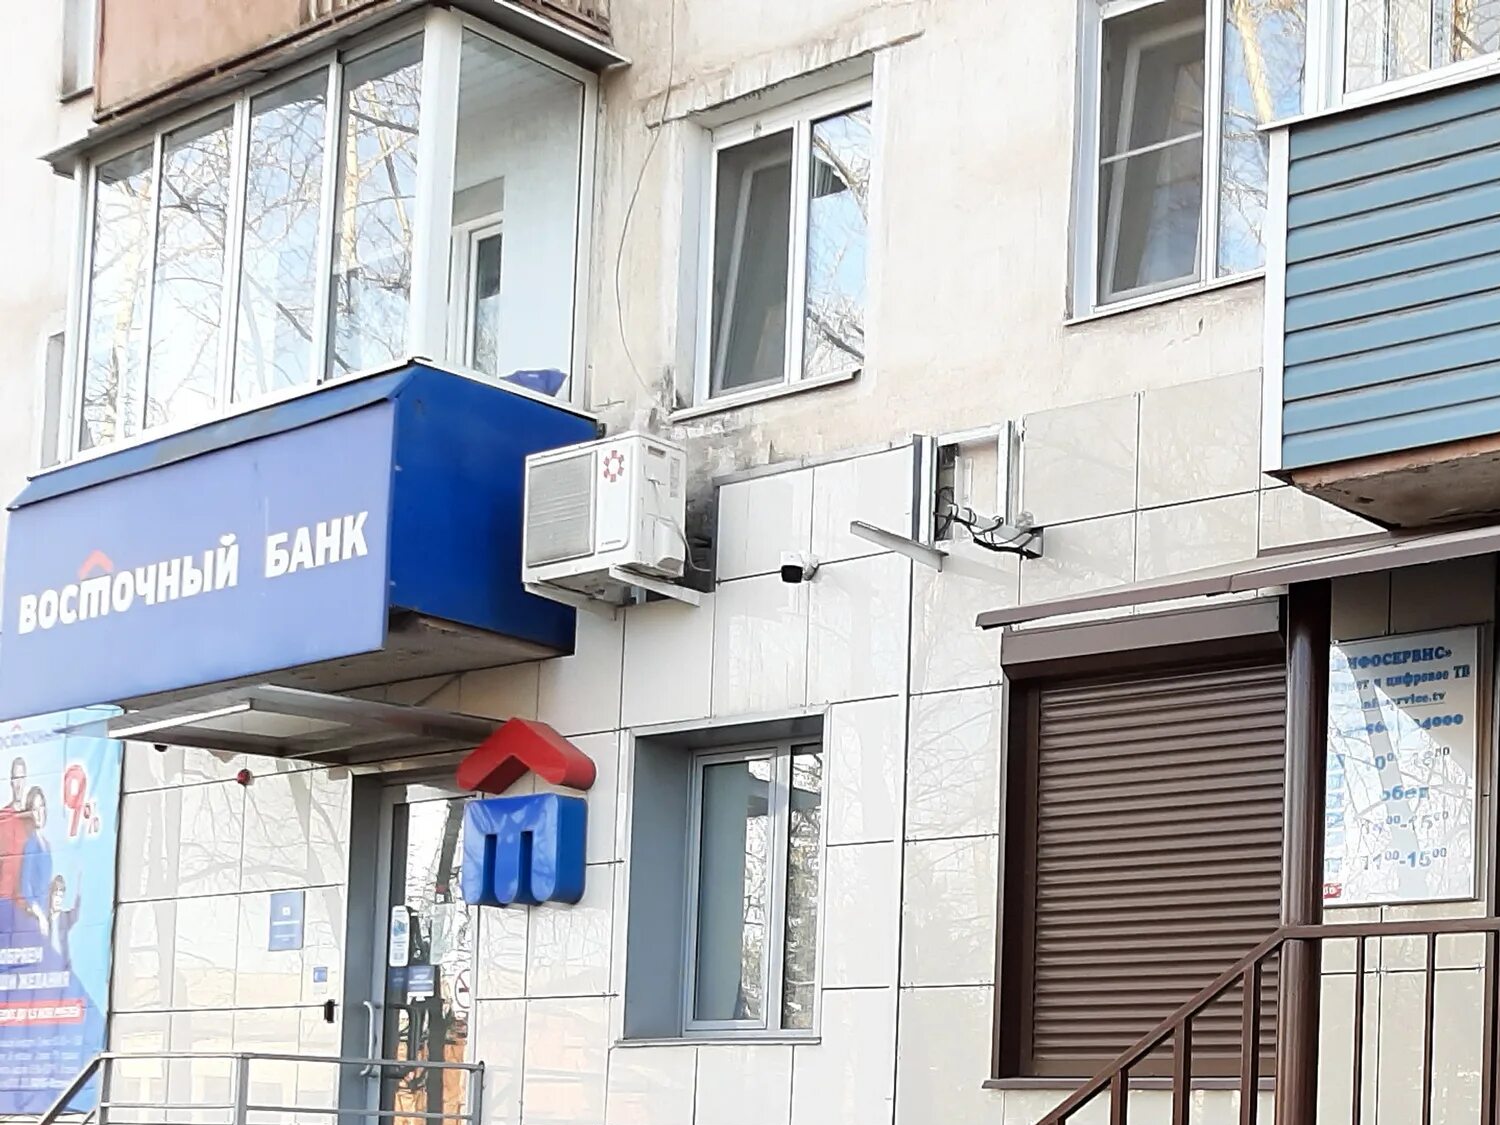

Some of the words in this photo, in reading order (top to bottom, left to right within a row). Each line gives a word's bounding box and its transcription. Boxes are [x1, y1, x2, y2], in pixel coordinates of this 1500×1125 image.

[18, 533, 240, 634] ВОСТОЧНЫЙ
[264, 511, 370, 579] БАНК
[1386, 672, 1449, 688] цифровое
[1453, 664, 1471, 679] ТВ
[63, 764, 100, 837] 9%
